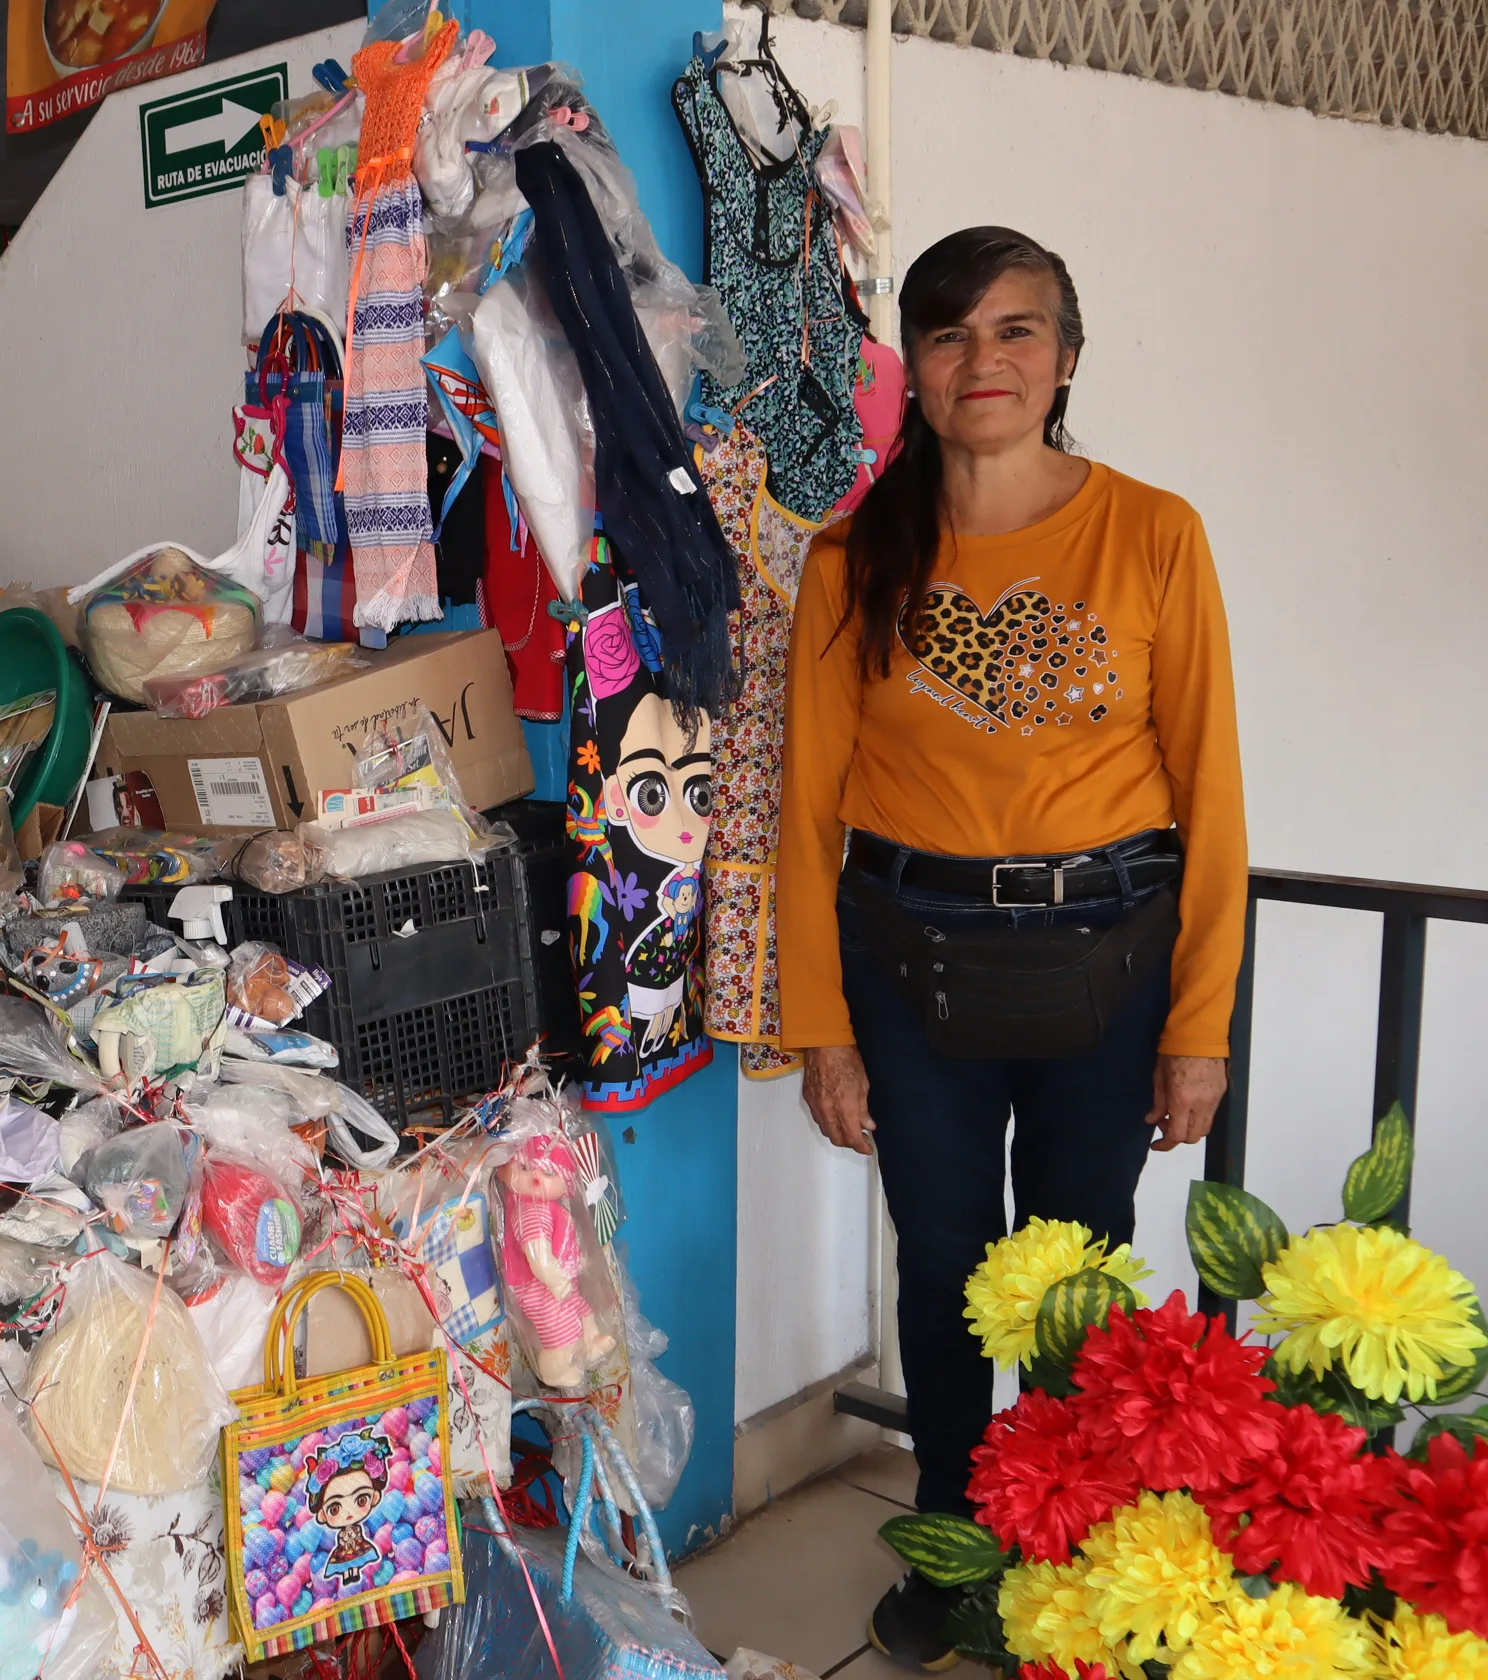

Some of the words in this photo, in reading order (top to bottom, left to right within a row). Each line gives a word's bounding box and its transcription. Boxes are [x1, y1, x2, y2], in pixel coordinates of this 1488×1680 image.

[23, 99, 34, 126] A
[38, 98, 53, 122] su
[56, 73, 112, 113] servicio
[114, 55, 165, 87] desde
[157, 170, 185, 190] RUTA
[187, 165, 203, 183] DE
[204, 146, 268, 178] EVACUACIÓ
[949, 701, 990, 729] heart
[267, 1221, 278, 1260] CUADRI
